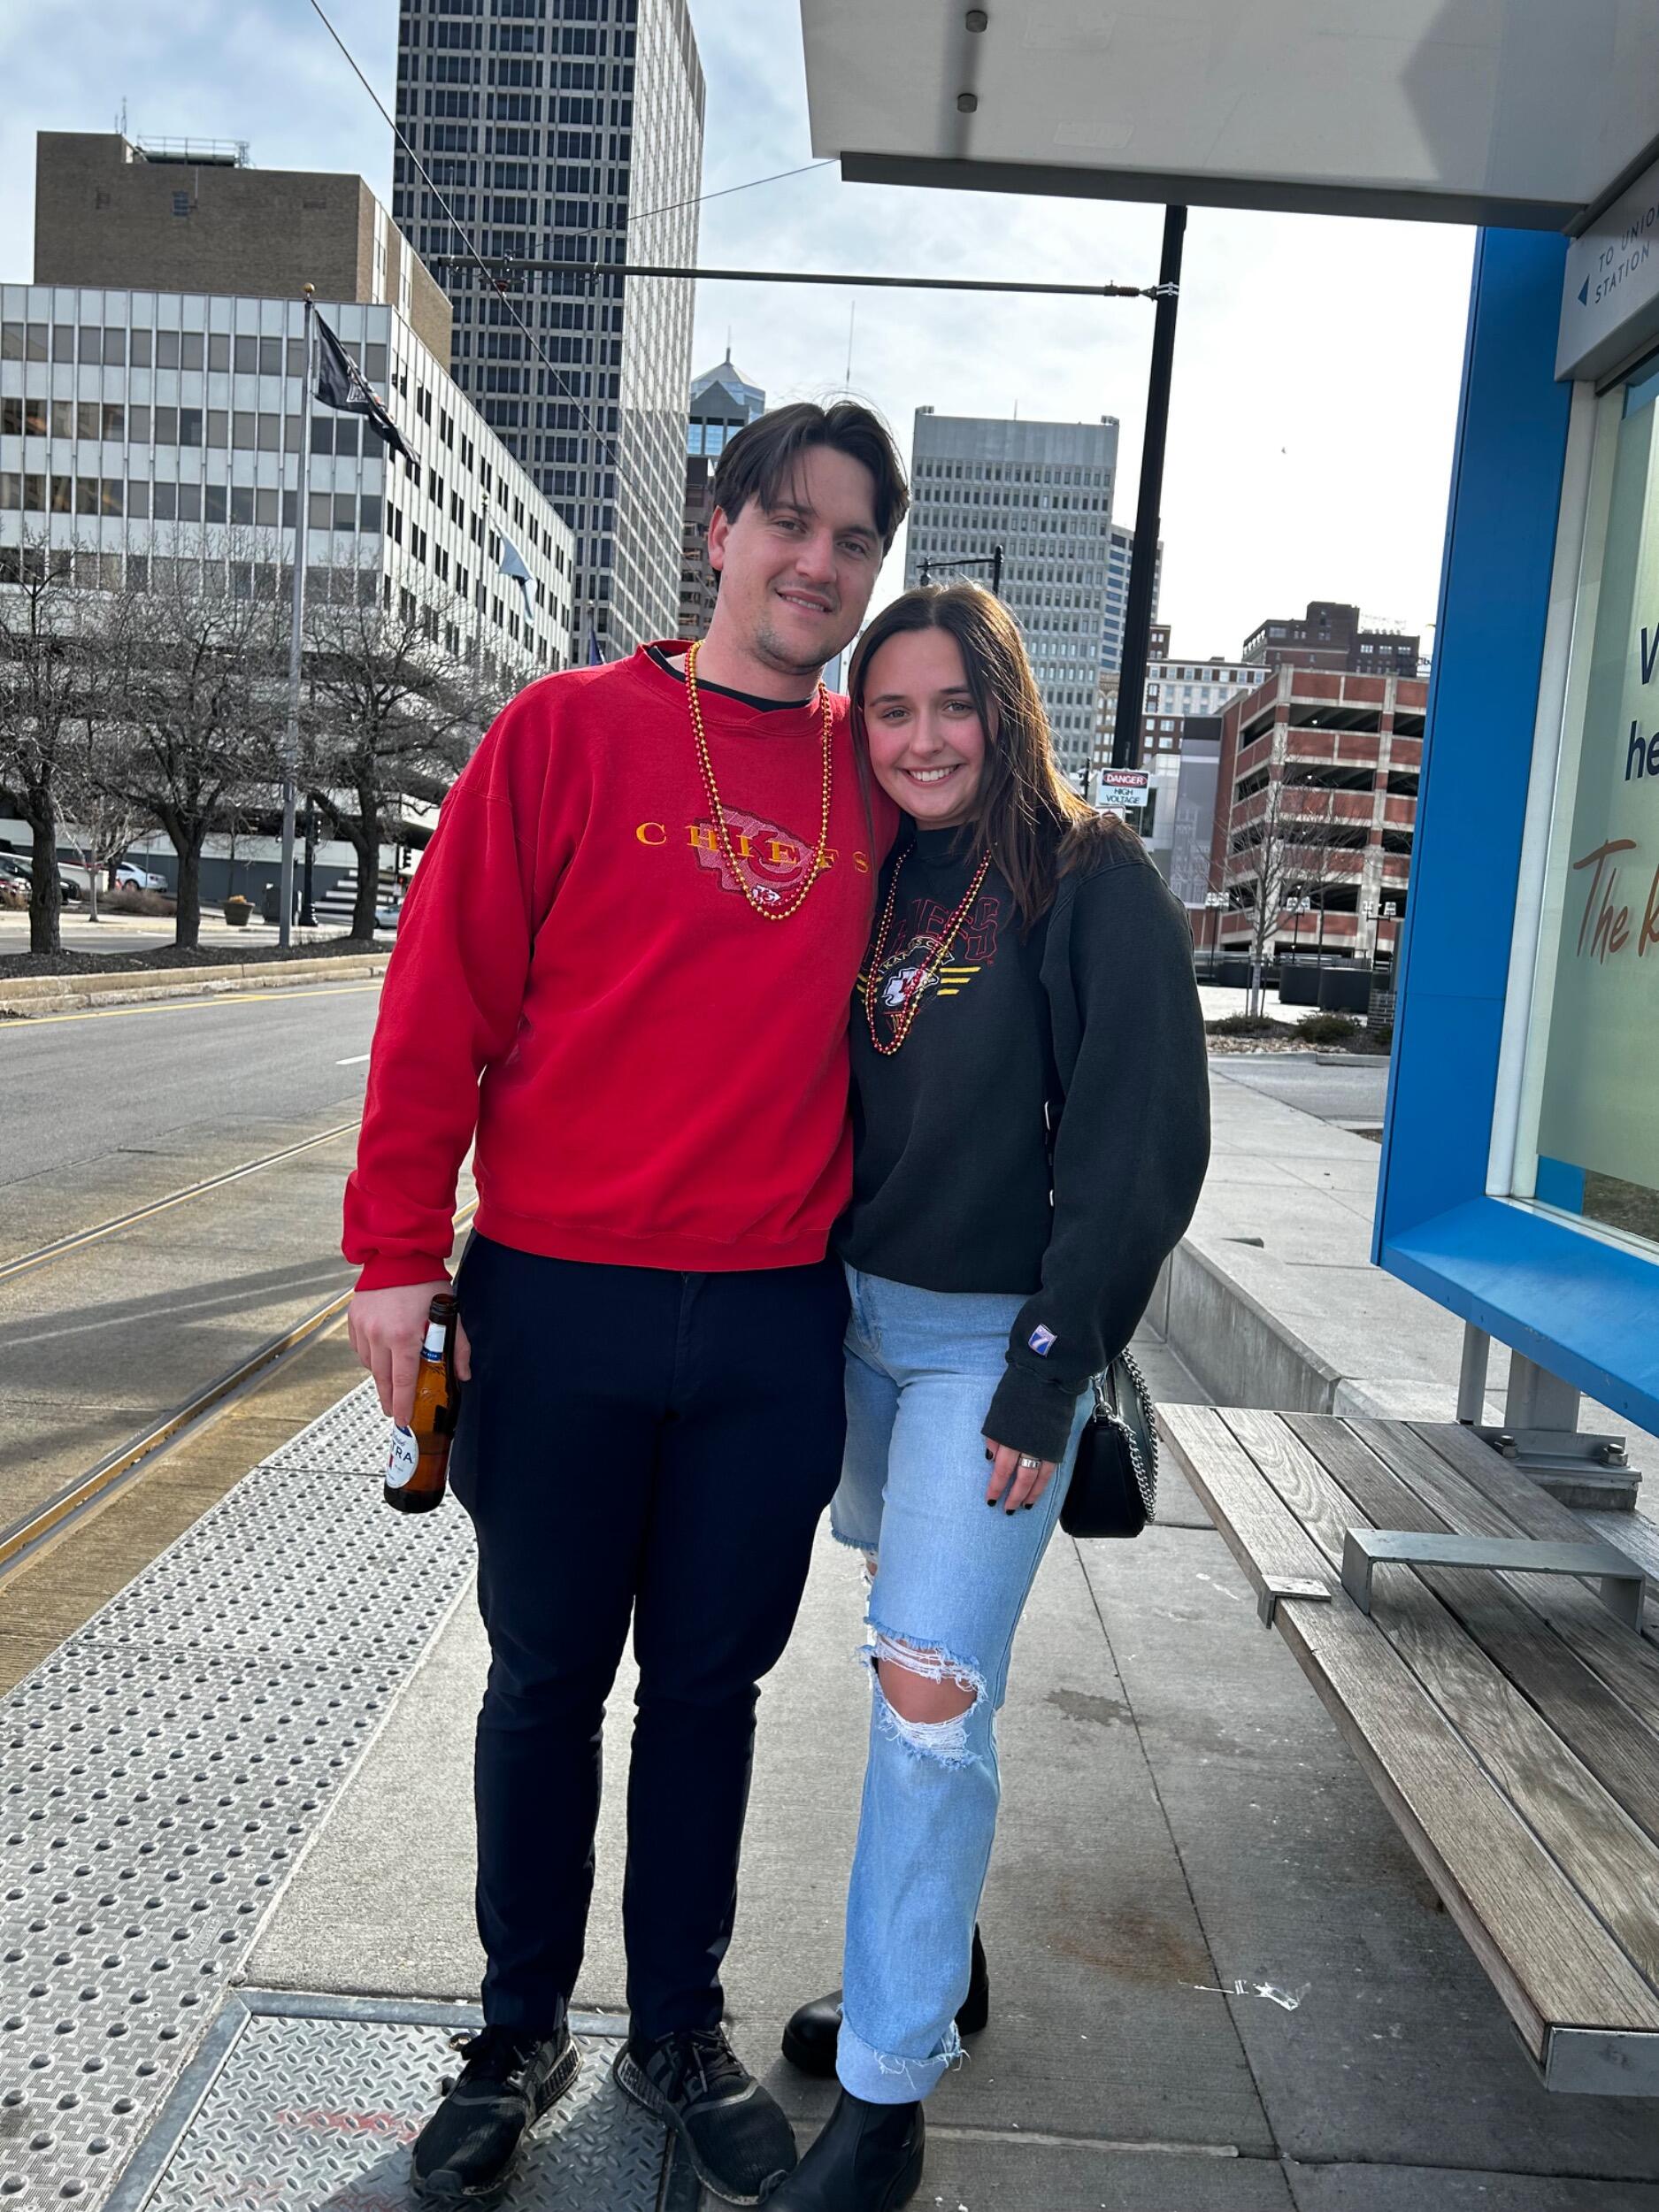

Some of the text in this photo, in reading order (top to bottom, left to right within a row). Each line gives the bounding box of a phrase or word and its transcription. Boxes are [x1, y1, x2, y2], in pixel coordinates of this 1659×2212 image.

[1599, 202, 1659, 272] TO UNIO
[1595, 241, 1650, 303] STATION
[1106, 774, 1144, 786] DANGER
[1106, 795, 1141, 804] VOLTAGE
[635, 821, 870, 873] CHIEFS
[1572, 839, 1637, 965] The
